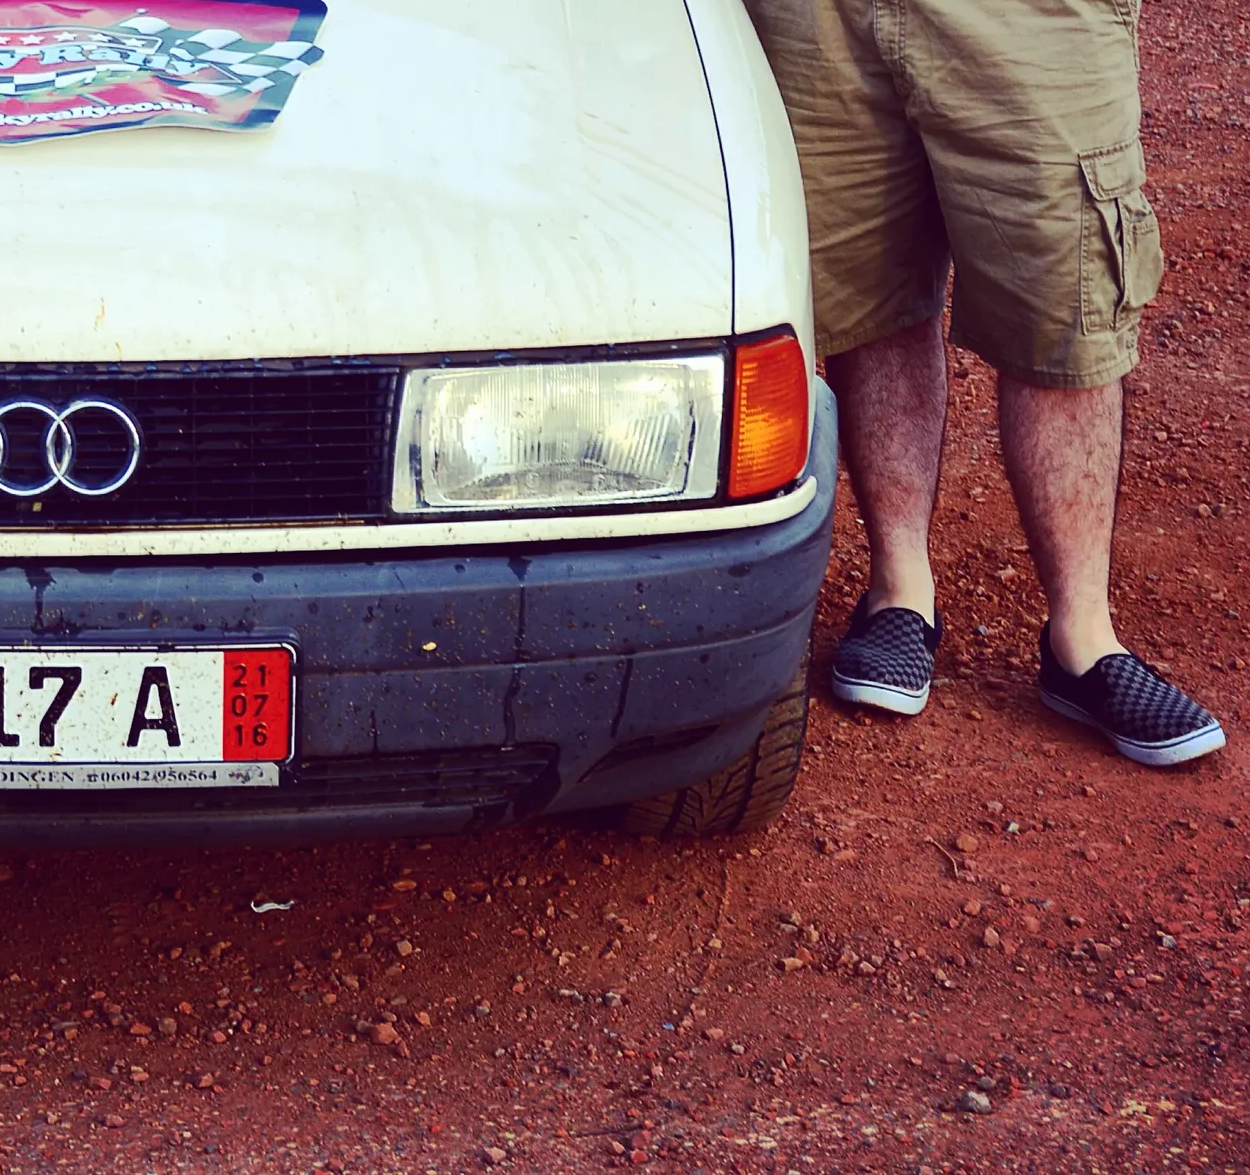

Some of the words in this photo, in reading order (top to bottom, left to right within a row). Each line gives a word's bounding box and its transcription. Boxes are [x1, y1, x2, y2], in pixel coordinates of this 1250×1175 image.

[39, 44, 211, 75] Rally
[232, 663, 267, 687] 21
[126, 665, 182, 748] A
[231, 693, 269, 717] 07
[235, 723, 268, 746] 16
